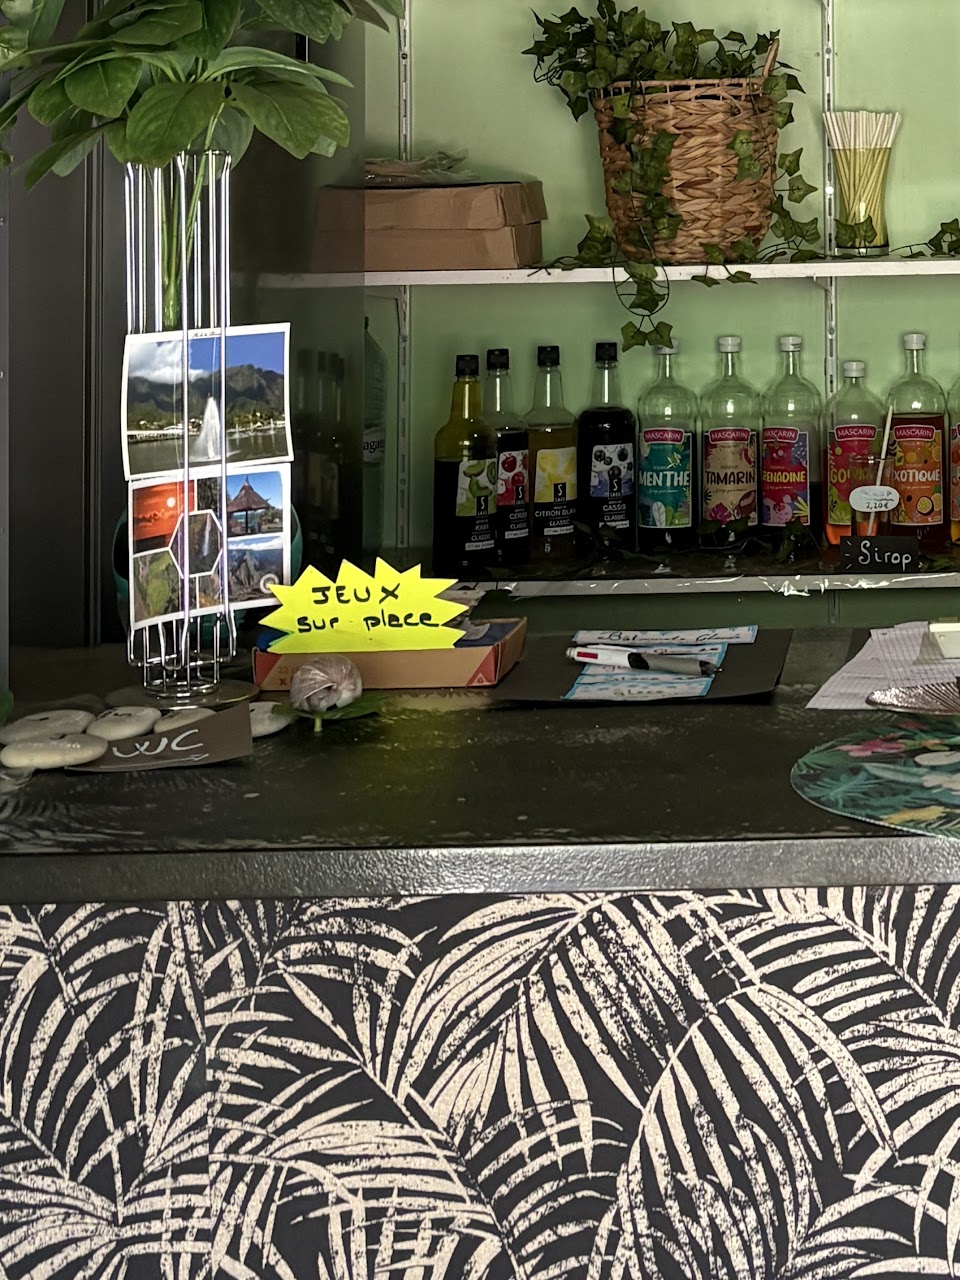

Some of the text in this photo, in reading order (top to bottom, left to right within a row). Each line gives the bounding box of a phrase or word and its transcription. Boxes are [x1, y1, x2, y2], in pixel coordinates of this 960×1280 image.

[644, 430, 683, 441] MASCARIN
[710, 429, 749, 440] MASCARIN
[836, 428, 875, 438] MASCARIN
[896, 428, 933, 438] MASCARIN
[638, 470, 690, 487] MENTHE
[762, 470, 806, 484] RENADINE
[893, 469, 941, 483] XOTIQUE
[858, 539, 912, 572] Sirop
[311, 582, 401, 606] JEUX
[363, 608, 443, 632] place
[111, 728, 204, 758] WC
